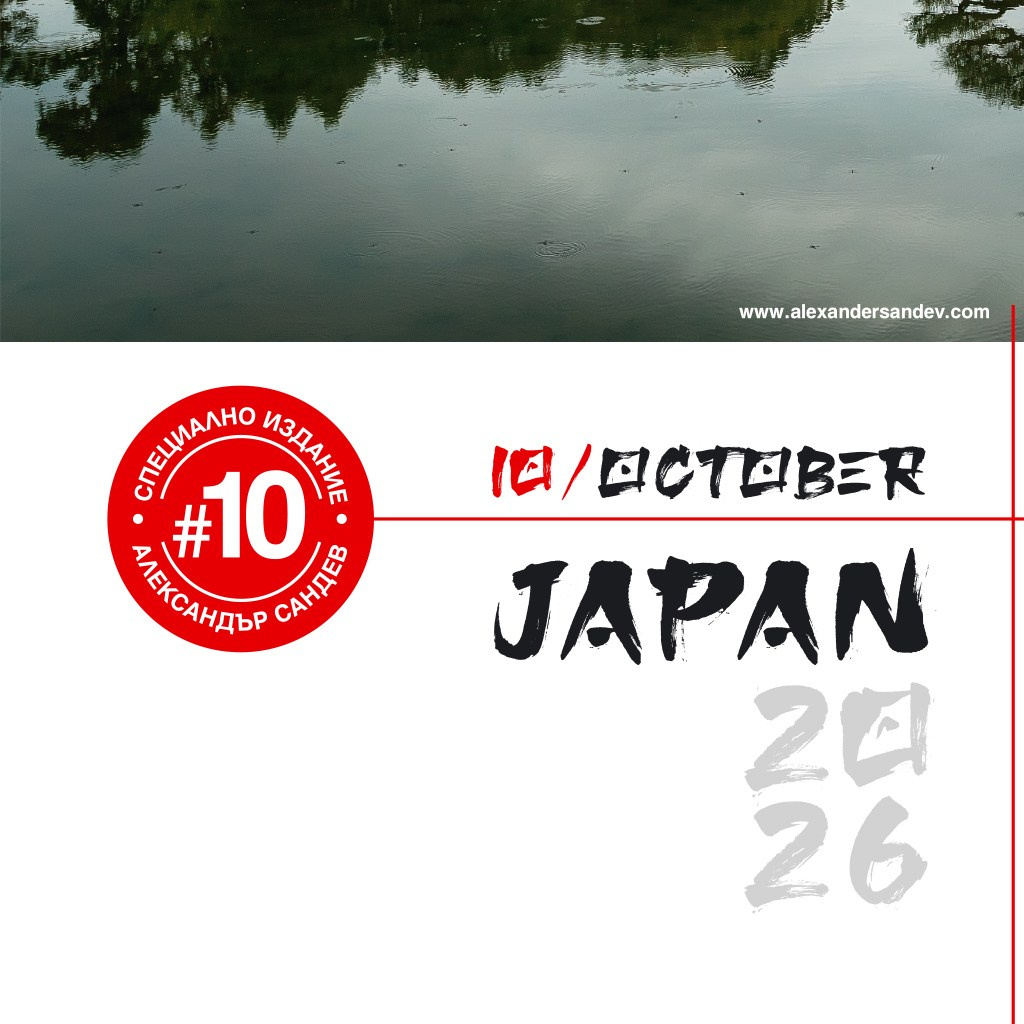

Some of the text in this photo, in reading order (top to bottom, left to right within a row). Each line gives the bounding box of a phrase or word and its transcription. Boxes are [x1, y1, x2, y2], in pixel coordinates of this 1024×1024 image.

[134, 406, 349, 505] СПЕЦИАЛНО ИЗДАНИЕ
[492, 444, 926, 501] 10/OCTOBER
[172, 470, 306, 560] #10
[131, 544, 348, 635] АЛЕКСАНДЪР САНДЕВ
[494, 548, 930, 666] JAPAN
[744, 682, 932, 792] 20
[744, 796, 929, 913] 26
